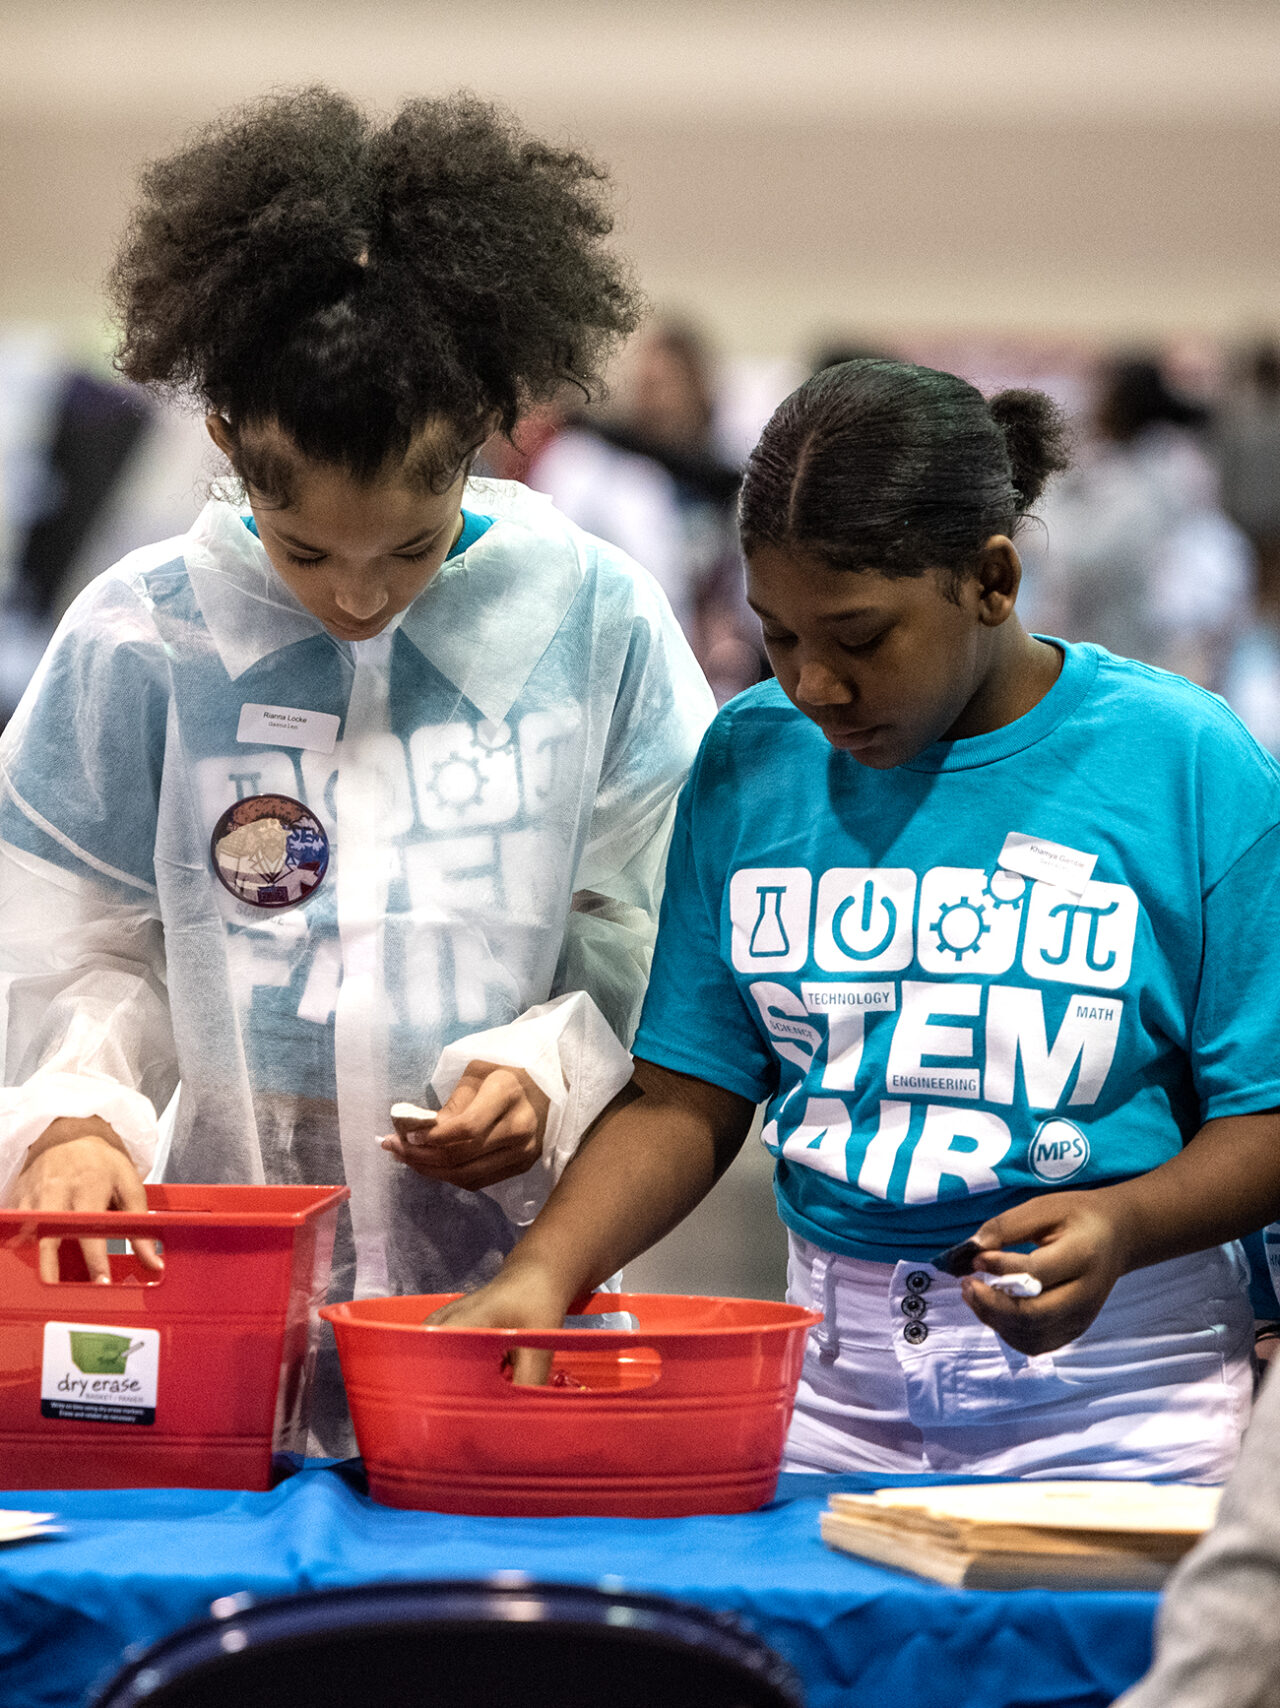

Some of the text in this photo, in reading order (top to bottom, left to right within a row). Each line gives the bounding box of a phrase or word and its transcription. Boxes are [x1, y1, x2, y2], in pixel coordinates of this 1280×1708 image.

[263, 711, 308, 724] Rianna Locke
[808, 991, 890, 1006] TECHNOLOGY
[1076, 1005, 1114, 1021] MATH
[769, 1020, 814, 1041] SCIENCE
[749, 980, 1124, 1109] STEM
[893, 1074, 977, 1091] ENGINEERING
[760, 1083, 1012, 1204] AIR
[1036, 1137, 1083, 1162] MPS
[57, 1372, 141, 1398] dry erase
